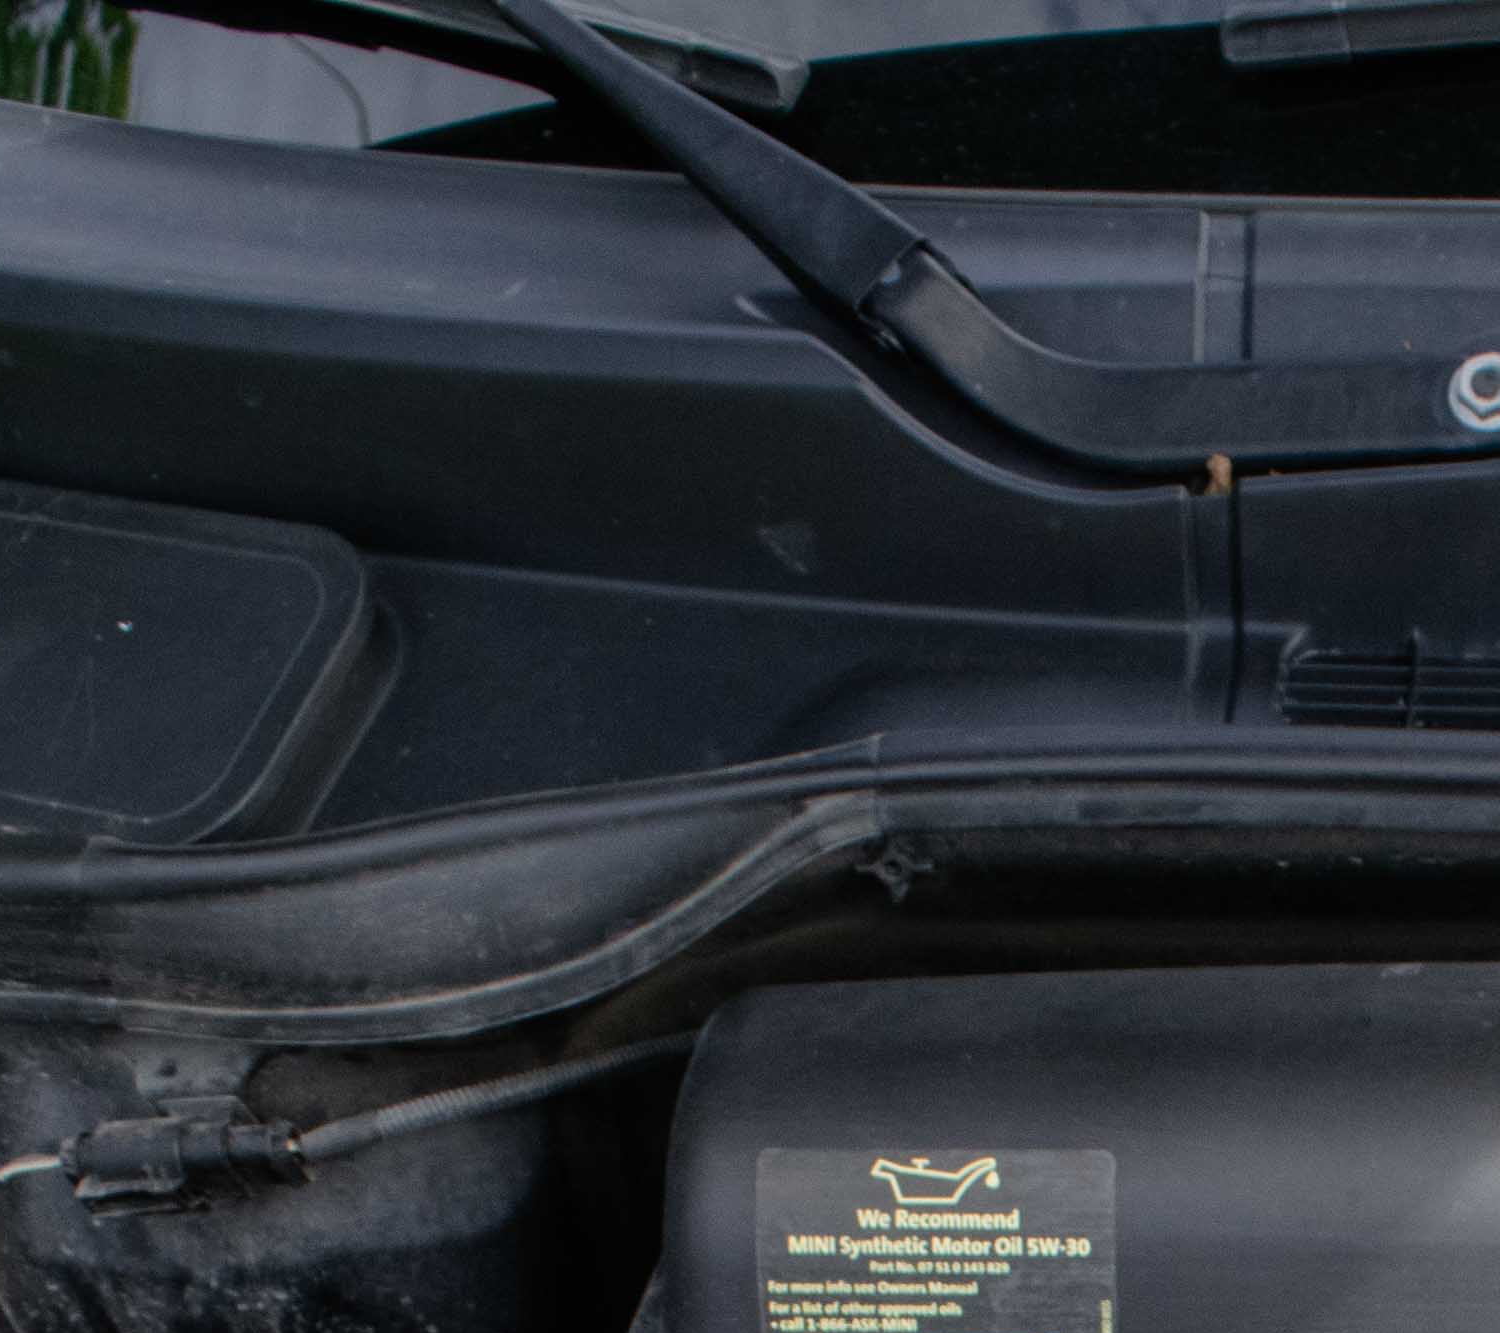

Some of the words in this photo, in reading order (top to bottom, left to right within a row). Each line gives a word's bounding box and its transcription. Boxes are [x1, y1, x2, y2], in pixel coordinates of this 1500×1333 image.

[857, 1209, 891, 1228] We
[895, 1209, 1020, 1229] Recommend
[787, 1236, 836, 1254] MINI
[840, 1236, 928, 1259] Synthetic
[931, 1237, 991, 1256] Motor
[994, 1237, 1023, 1257] Oil
[1027, 1238, 1092, 1257] 5W-30
[868, 1260, 894, 1274] Part
[767, 1280, 788, 1295] For
[789, 1282, 824, 1295] more
[825, 1280, 852, 1295] info
[853, 1283, 876, 1295] see
[928, 1281, 979, 1295] Manual
[769, 1302, 790, 1316] For
[791, 1304, 800, 1316] a
[801, 1302, 823, 1316] list
[824, 1302, 839, 1316] of
[840, 1302, 876, 1317] other
[877, 1302, 937, 1319] approved
[939, 1302, 963, 1317] oils
[780, 1317, 804, 1332] call
